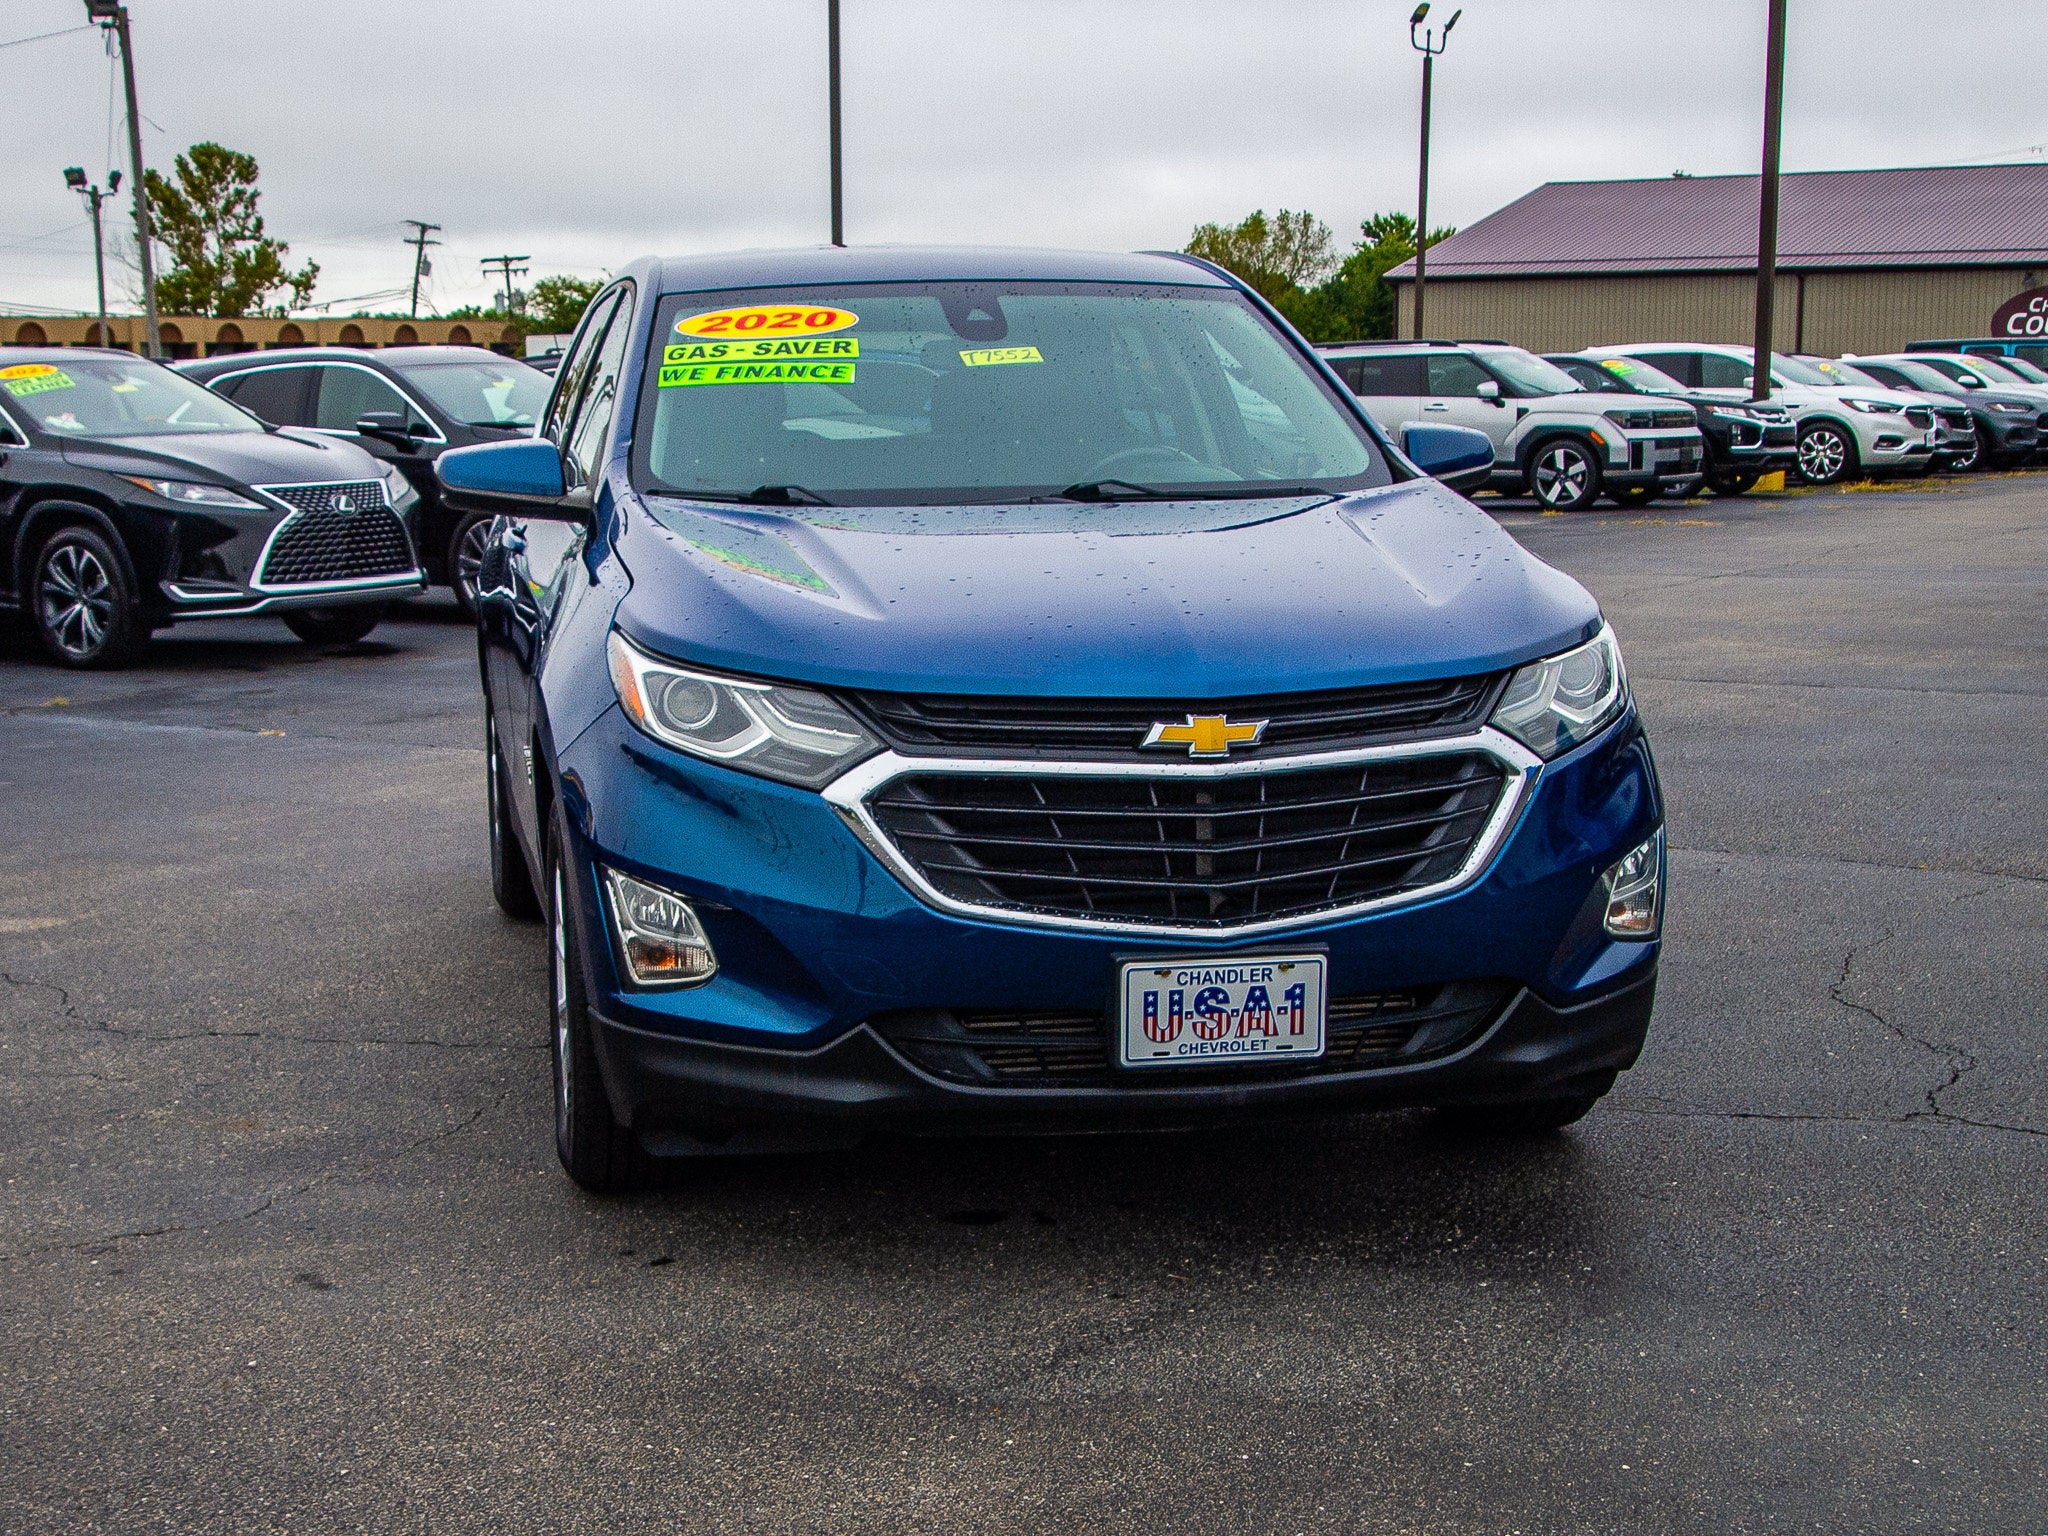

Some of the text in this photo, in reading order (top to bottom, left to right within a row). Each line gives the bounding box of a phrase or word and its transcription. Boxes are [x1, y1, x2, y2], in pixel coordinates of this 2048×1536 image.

[696, 311, 838, 334] 2020
[2006, 312, 2048, 335] CO
[963, 349, 1039, 365] T7552
[662, 364, 849, 382] WE FINANCE
[1176, 967, 1274, 986] CHANDLER
[1178, 1039, 1269, 1055] CHEVROLET
